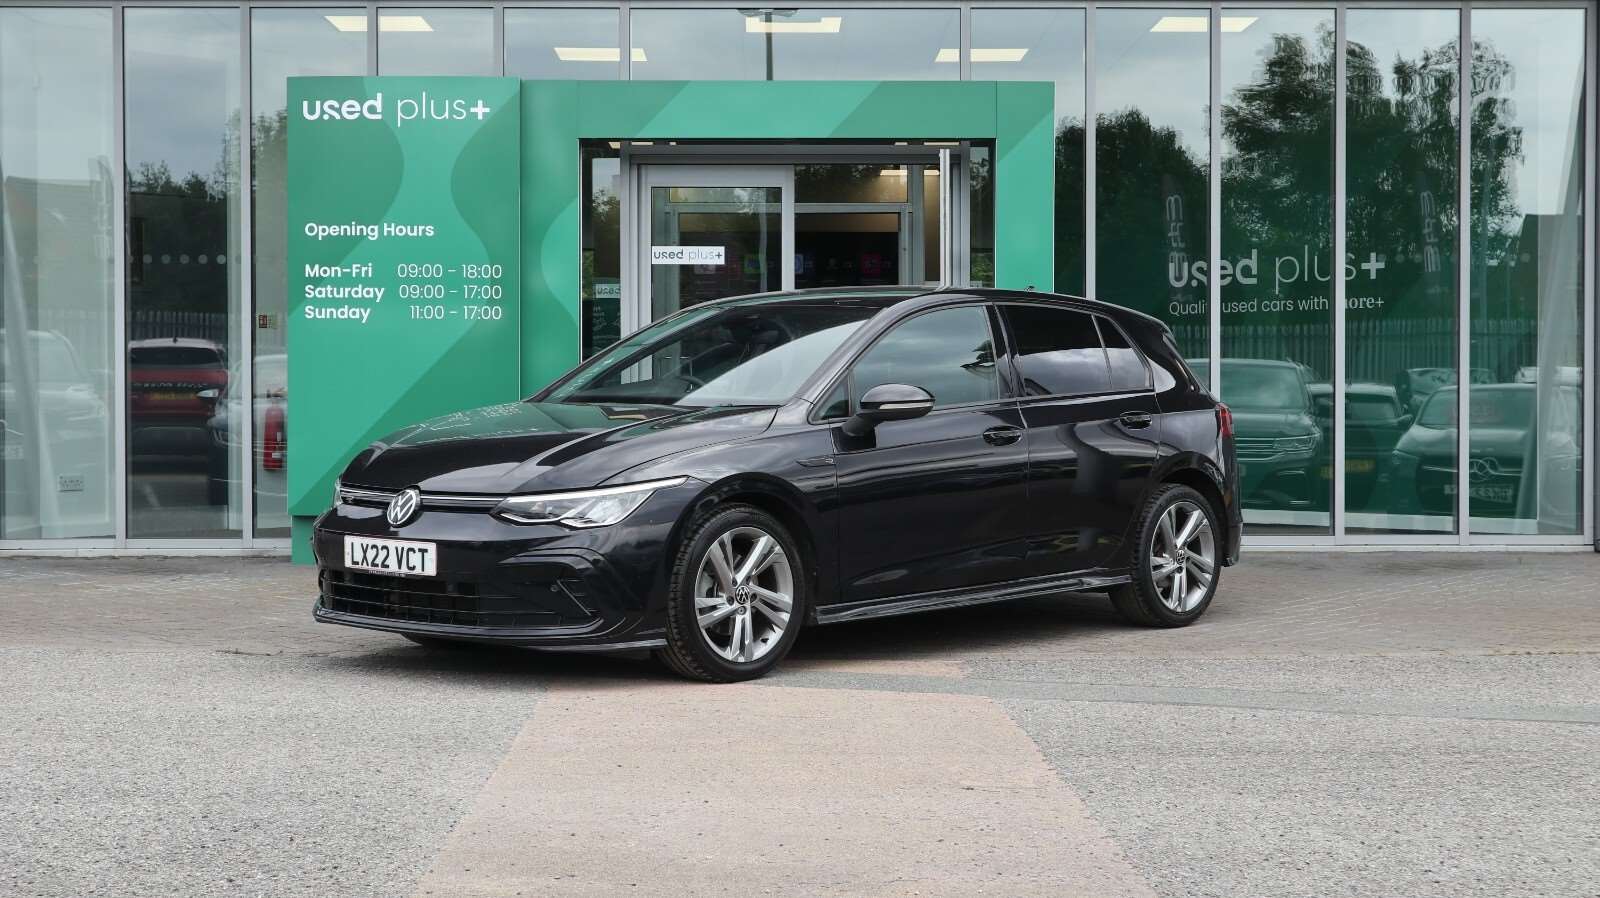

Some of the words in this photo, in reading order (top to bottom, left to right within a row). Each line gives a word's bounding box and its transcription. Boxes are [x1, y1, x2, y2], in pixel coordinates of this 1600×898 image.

[302, 92, 383, 120] used
[304, 222, 379, 240] Opening
[383, 223, 434, 236] Hours
[653, 248, 684, 260] used
[304, 263, 373, 278] Mon-Fri
[397, 264, 443, 278] 09:00
[462, 264, 503, 279] 18:00
[304, 285, 385, 303] Saturday
[399, 285, 445, 299] 09:00
[463, 285, 503, 299] 17:00
[1222, 301, 1257, 313] used
[1261, 300, 1294, 312] cars
[1297, 296, 1329, 311] with
[1345, 297, 1384, 310] ore+
[304, 306, 371, 323] Sunday
[411, 306, 445, 320] 11:00
[463, 306, 503, 320] 17:00
[350, 541, 391, 569] LX22
[394, 546, 429, 572] VCT
